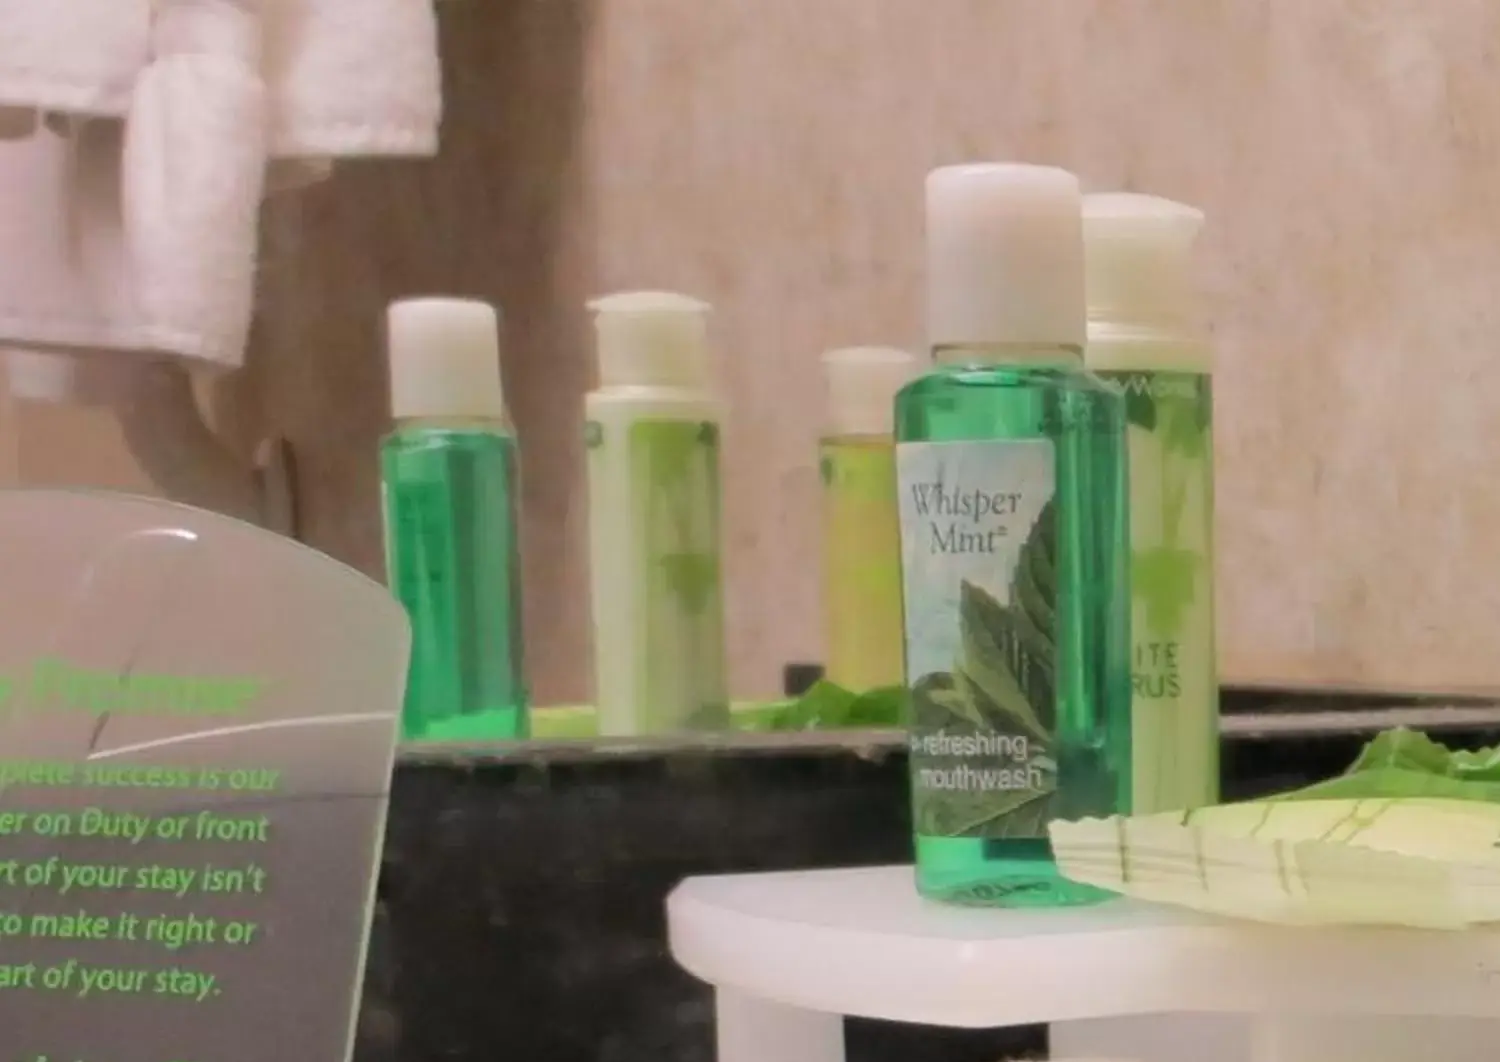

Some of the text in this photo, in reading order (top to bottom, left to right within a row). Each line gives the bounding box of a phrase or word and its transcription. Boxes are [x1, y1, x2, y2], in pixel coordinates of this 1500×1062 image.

[912, 482, 1022, 524] Whisper
[1136, 641, 1180, 669] ITE
[922, 728, 1029, 764] refreshing
[83, 762, 190, 790] success
[228, 767, 282, 791] our
[33, 811, 72, 836] on
[79, 806, 150, 845] Duty
[156, 814, 190, 841] or
[196, 809, 271, 843] front
[24, 855, 59, 886] of
[59, 864, 128, 896] your
[135, 864, 197, 899] stay
[203, 861, 267, 894] isn't
[31, 908, 110, 940] make
[117, 910, 140, 941] it
[145, 911, 218, 951] right
[224, 920, 257, 945] or
[43, 957, 78, 990] of
[77, 966, 148, 999] your
[153, 966, 222, 1003] stay.
